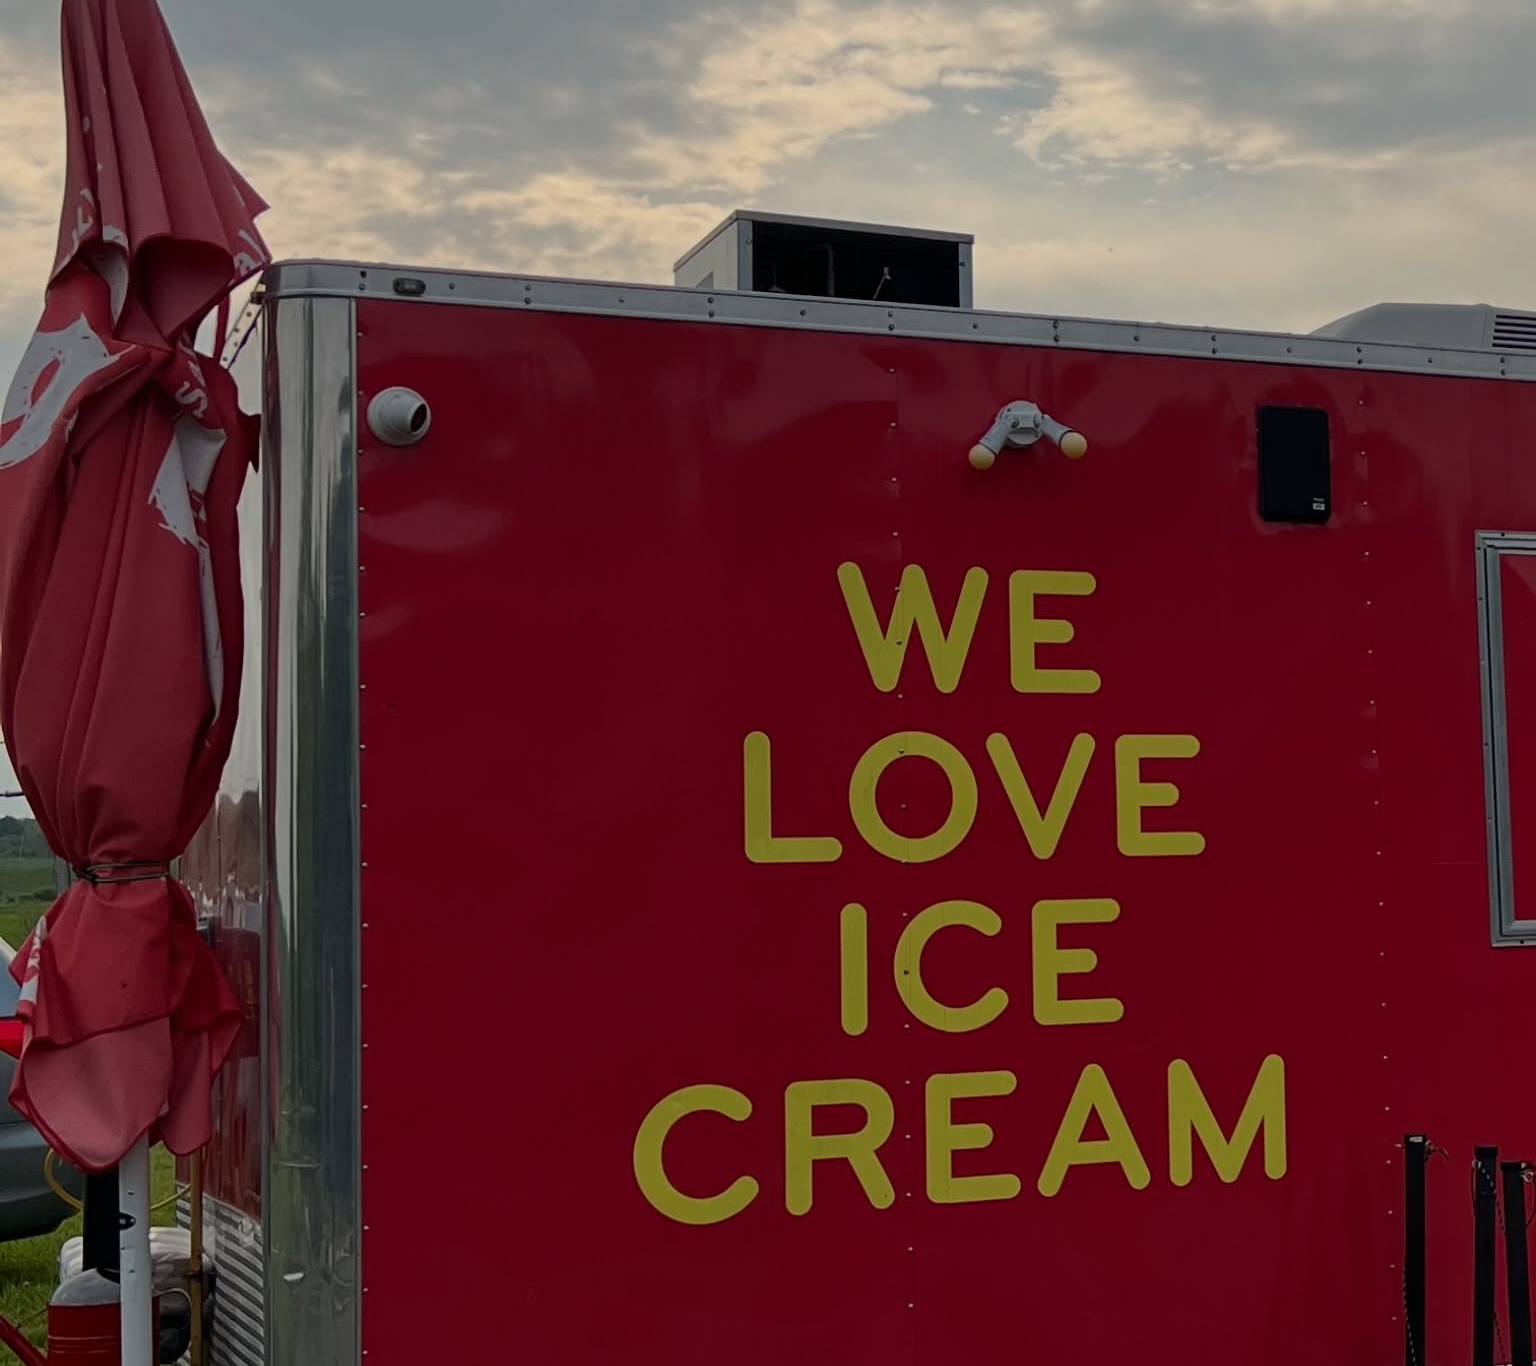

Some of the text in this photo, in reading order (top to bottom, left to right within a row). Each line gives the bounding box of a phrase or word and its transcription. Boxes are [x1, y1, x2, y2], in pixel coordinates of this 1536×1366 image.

[837, 562, 1101, 694] WE
[744, 731, 1205, 864] LOVE
[839, 898, 1125, 1036] ICE
[633, 1053, 1288, 1226] CREAM
